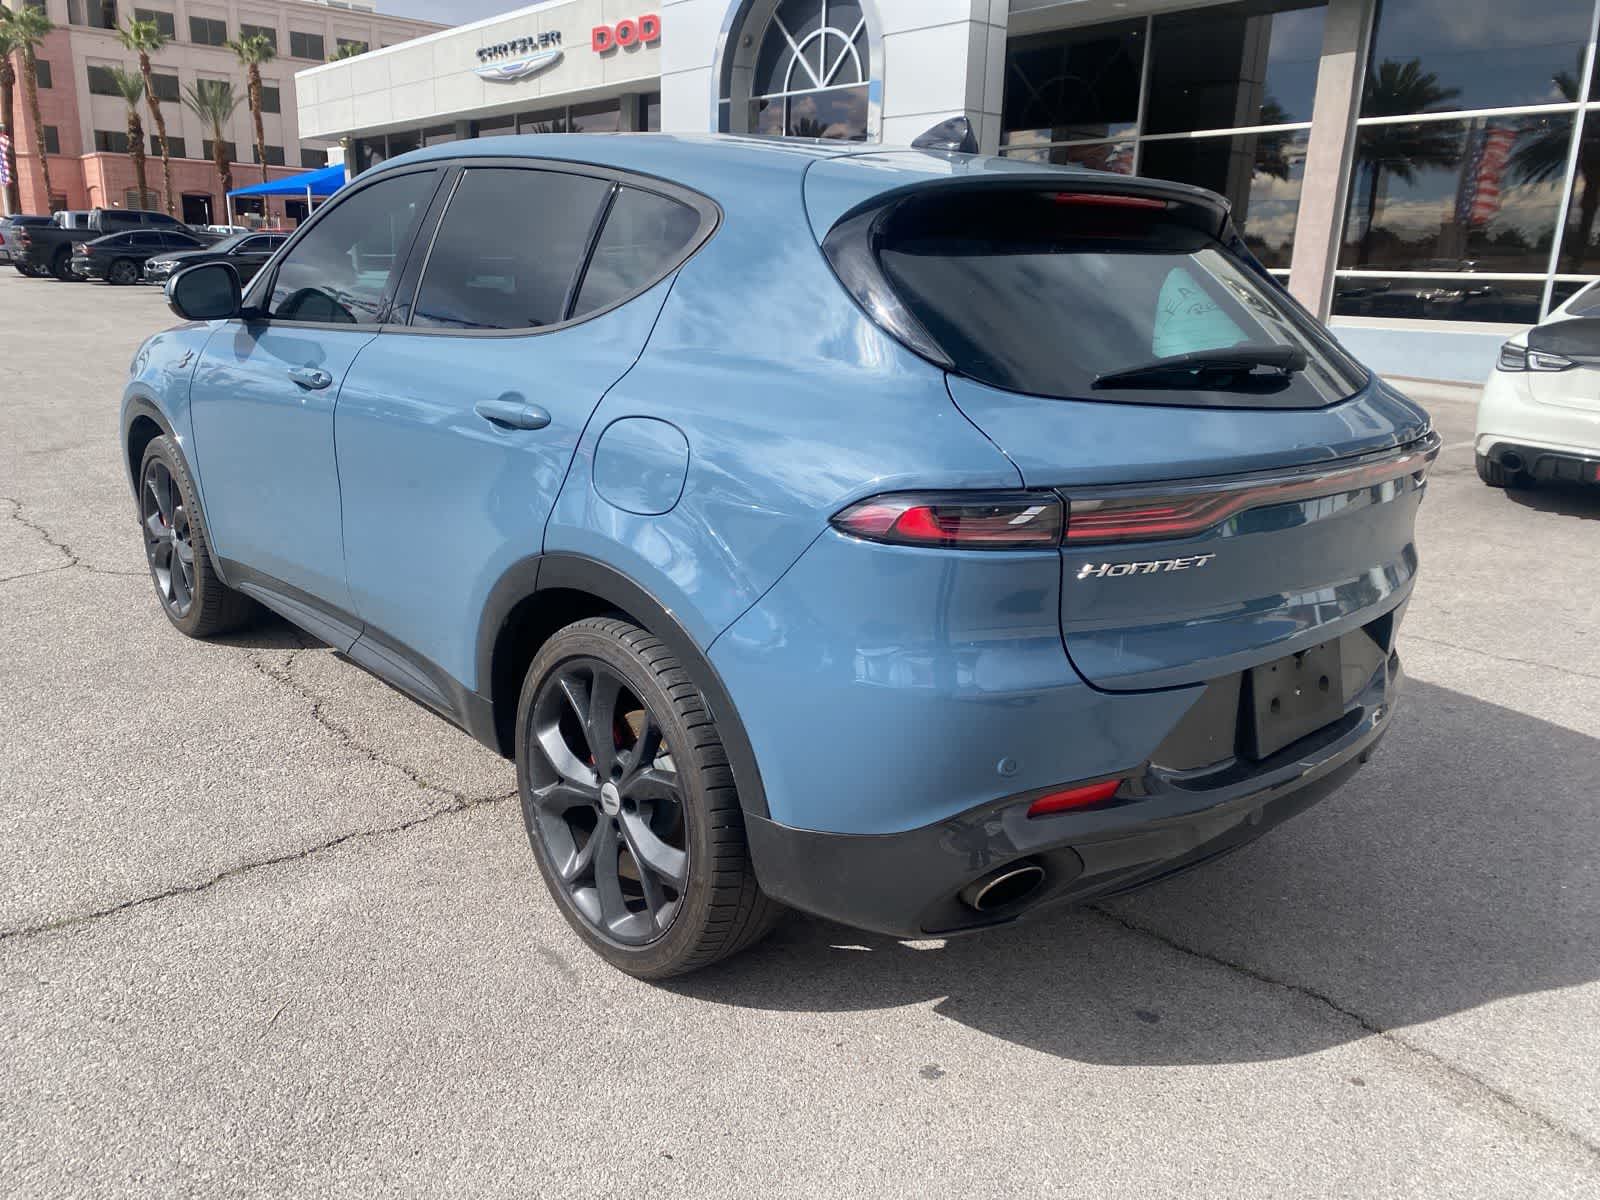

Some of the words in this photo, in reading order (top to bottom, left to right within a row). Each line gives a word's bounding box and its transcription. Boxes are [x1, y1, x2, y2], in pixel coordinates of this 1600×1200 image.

[477, 31, 562, 62] CHRYSLER
[591, 14, 661, 53] DOD
[1076, 552, 1217, 580] HORNET
